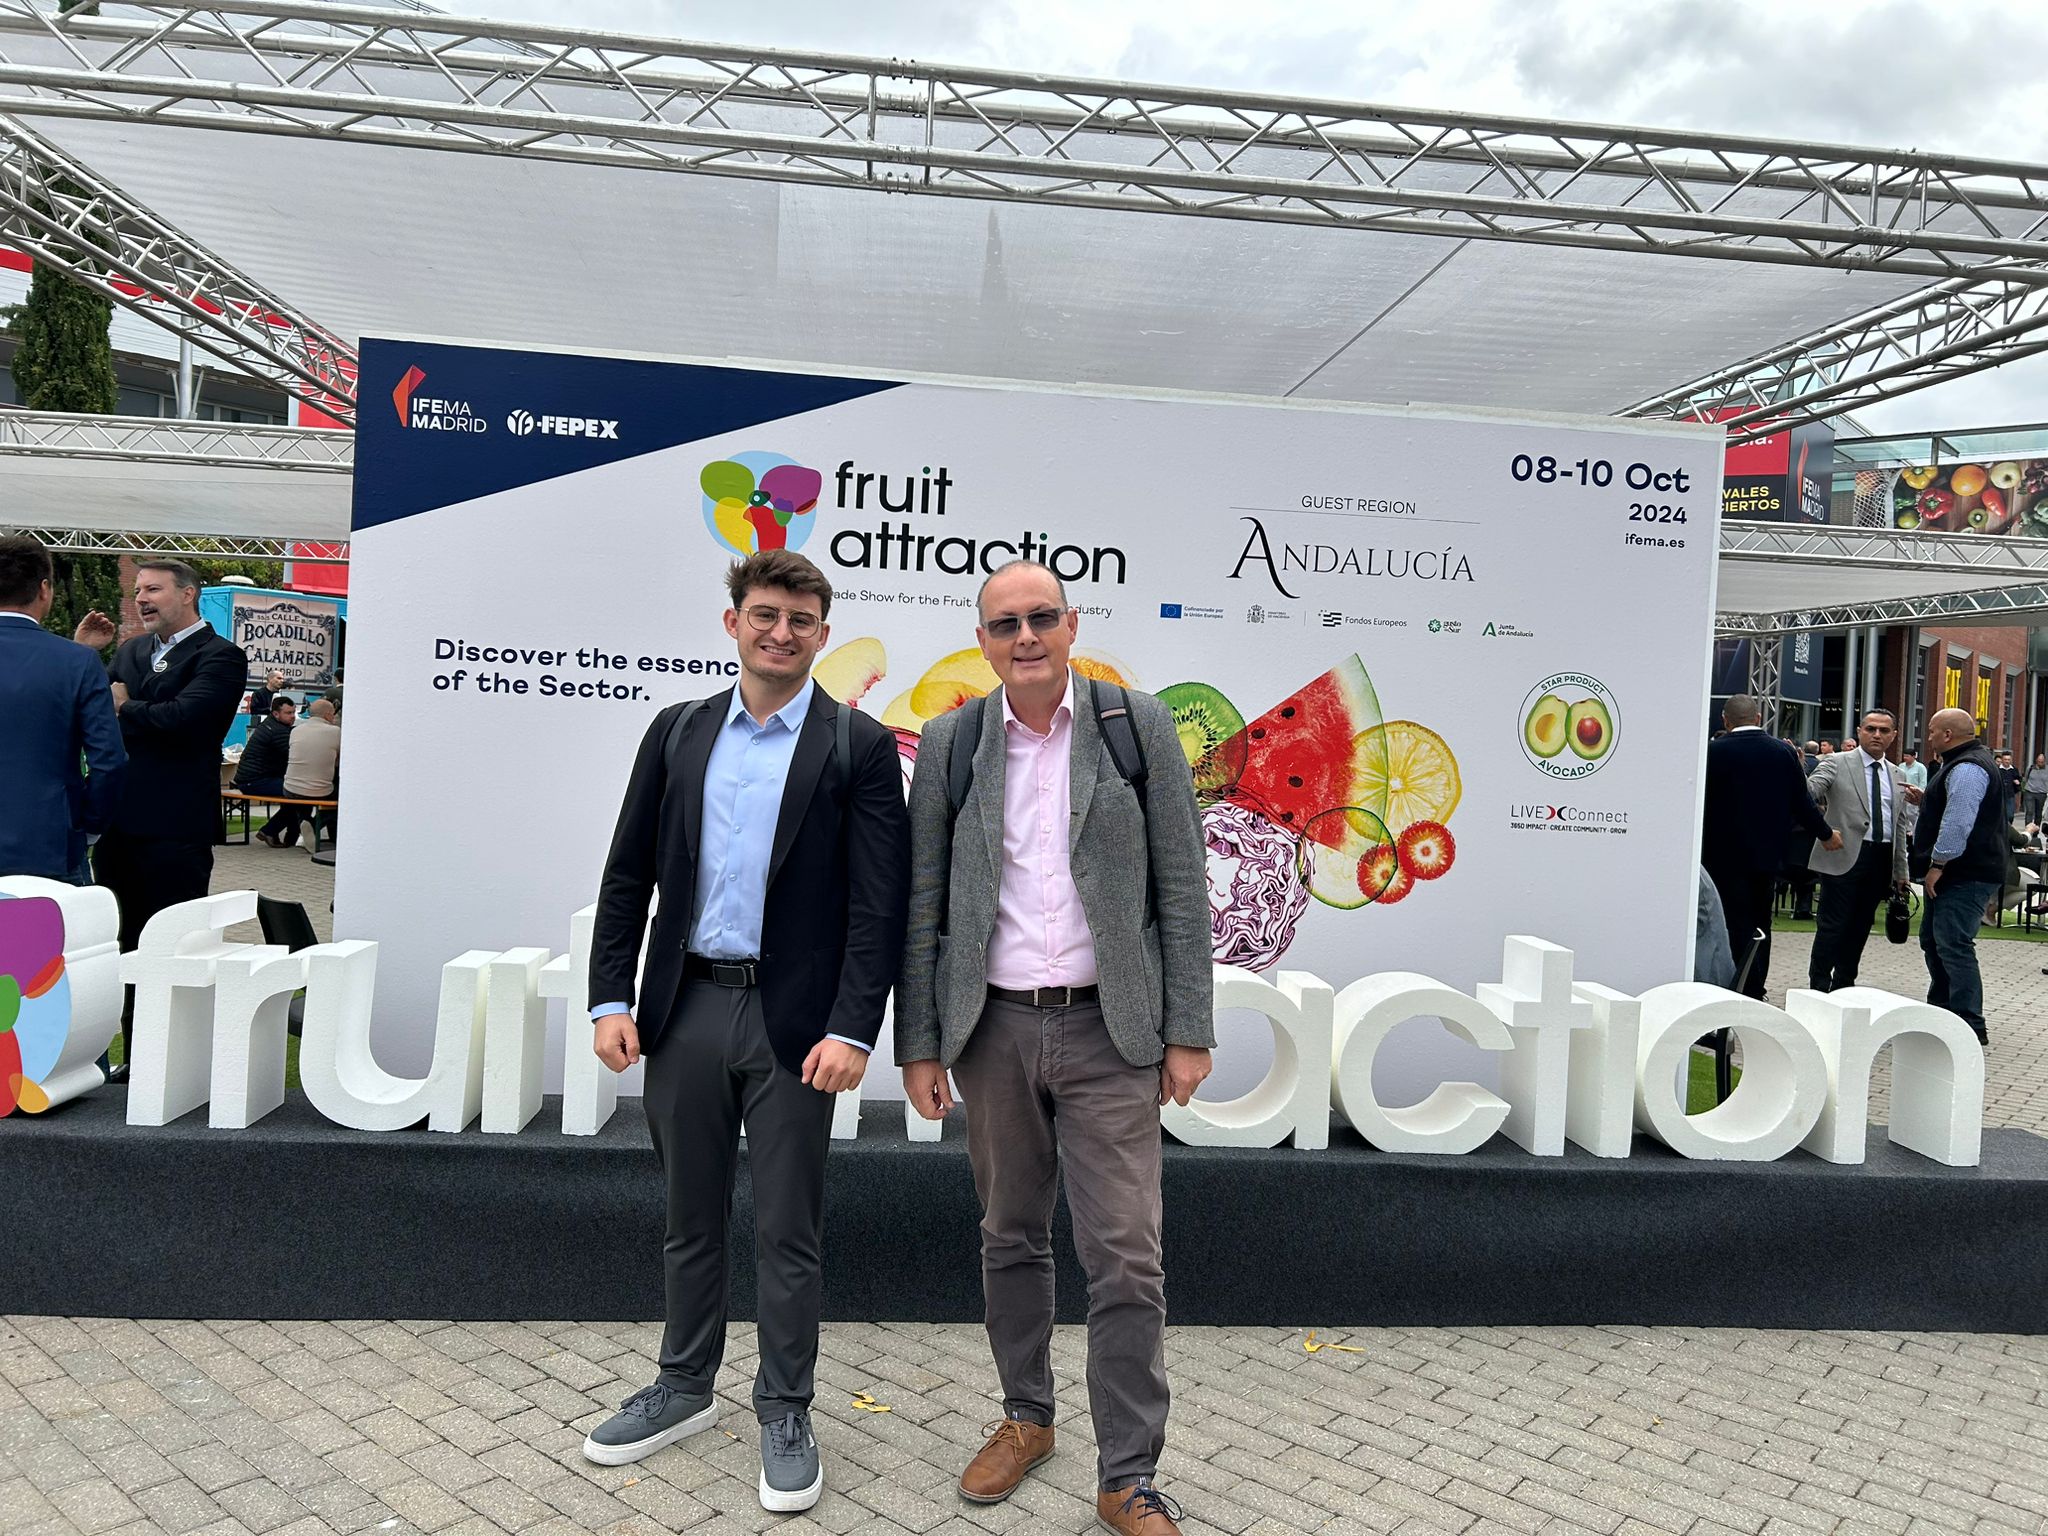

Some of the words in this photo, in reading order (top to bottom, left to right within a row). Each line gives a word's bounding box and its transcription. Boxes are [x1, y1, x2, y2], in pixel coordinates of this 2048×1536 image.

[412, 397, 472, 417] IFEMA
[411, 414, 487, 434] MADRID
[536, 415, 620, 440] FEPEX
[1510, 452, 1614, 488] 08-10
[1624, 462, 1691, 494] Oct
[835, 460, 953, 516] fruit
[1722, 486, 1770, 499] VALES
[1301, 494, 1354, 512] GUEST
[1357, 497, 1417, 516] REGION
[1628, 502, 1688, 526] 2024
[1801, 494, 1825, 521] MADRID
[1624, 532, 1687, 550] ifema.es
[830, 521, 1127, 584] attraction
[1226, 516, 1477, 600] ANDALUCÍA
[832, 589, 857, 601] ade
[859, 589, 895, 603] Show
[898, 592, 915, 604] for
[918, 594, 940, 606] the
[943, 595, 972, 608] Fruit
[271, 613, 300, 622] CALLE
[1069, 603, 1113, 619] dustry
[1345, 616, 1372, 625] Fondos
[1373, 617, 1408, 628] Europeos
[243, 623, 326, 647] BOCADILLO
[1505, 629, 1534, 638] Andalucía
[434, 637, 568, 667] Discover
[576, 647, 628, 671] the
[637, 656, 740, 677] essenc
[265, 667, 302, 677] MDRID
[432, 669, 468, 692] of
[476, 671, 529, 695] the
[539, 674, 652, 703] Sector.
[1541, 676, 1563, 692] STAR
[1564, 675, 1606, 695] PRODUCT
[1538, 759, 1596, 778] AVOCADO
[1510, 804, 1545, 820] LIVE
[1568, 806, 1629, 824] Connect
[1525, 823, 1547, 831] IMPACT
[1549, 824, 1573, 832] CREATE
[1573, 825, 1607, 835] COMMUNITY
